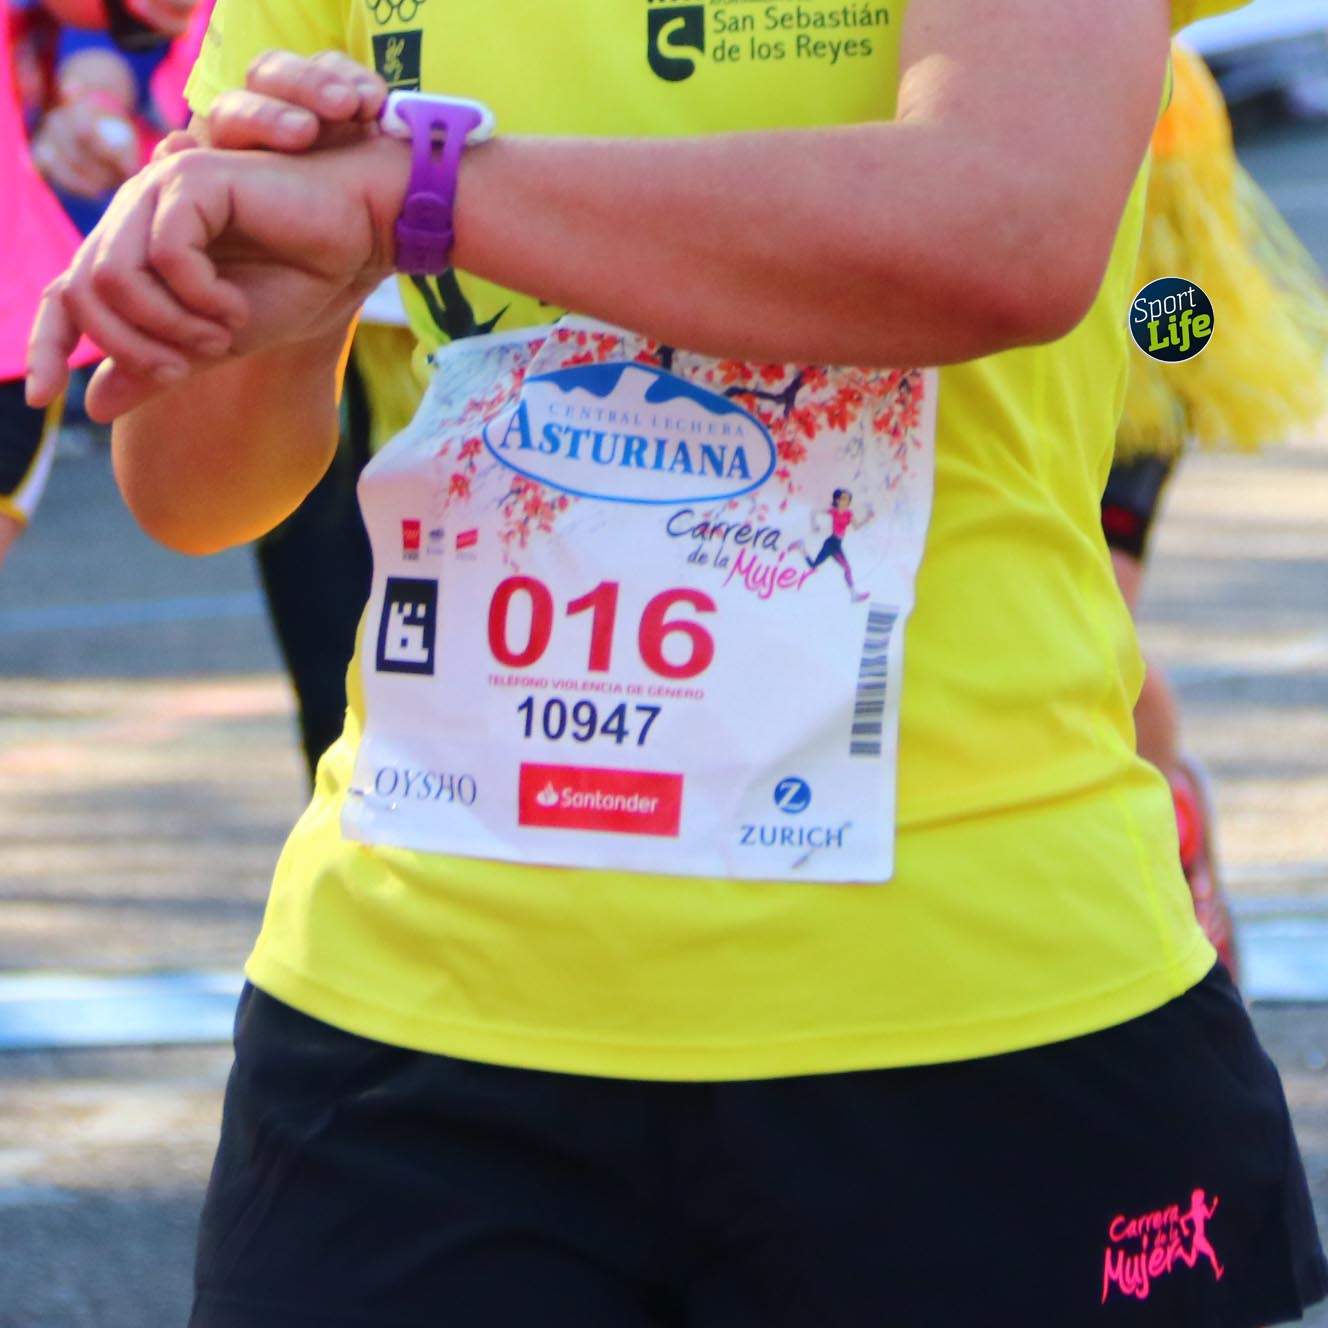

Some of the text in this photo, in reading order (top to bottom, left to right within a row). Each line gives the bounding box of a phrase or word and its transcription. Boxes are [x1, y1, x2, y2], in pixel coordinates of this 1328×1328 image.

[712, 2, 889, 34] San Sebastián
[712, 33, 873, 65] de los Reyes
[499, 398, 752, 480] ASTURIANA
[548, 403, 745, 437] CENTRAL LECHERA
[666, 508, 782, 551] Carrera
[686, 544, 730, 568] de la
[723, 547, 816, 600] Mujer
[487, 574, 717, 681] 016
[516, 694, 663, 747] 10947
[374, 766, 660, 814] OYSHO Santander
[739, 824, 843, 848] ZURICH
[1101, 1234, 1184, 1305] Mujer
